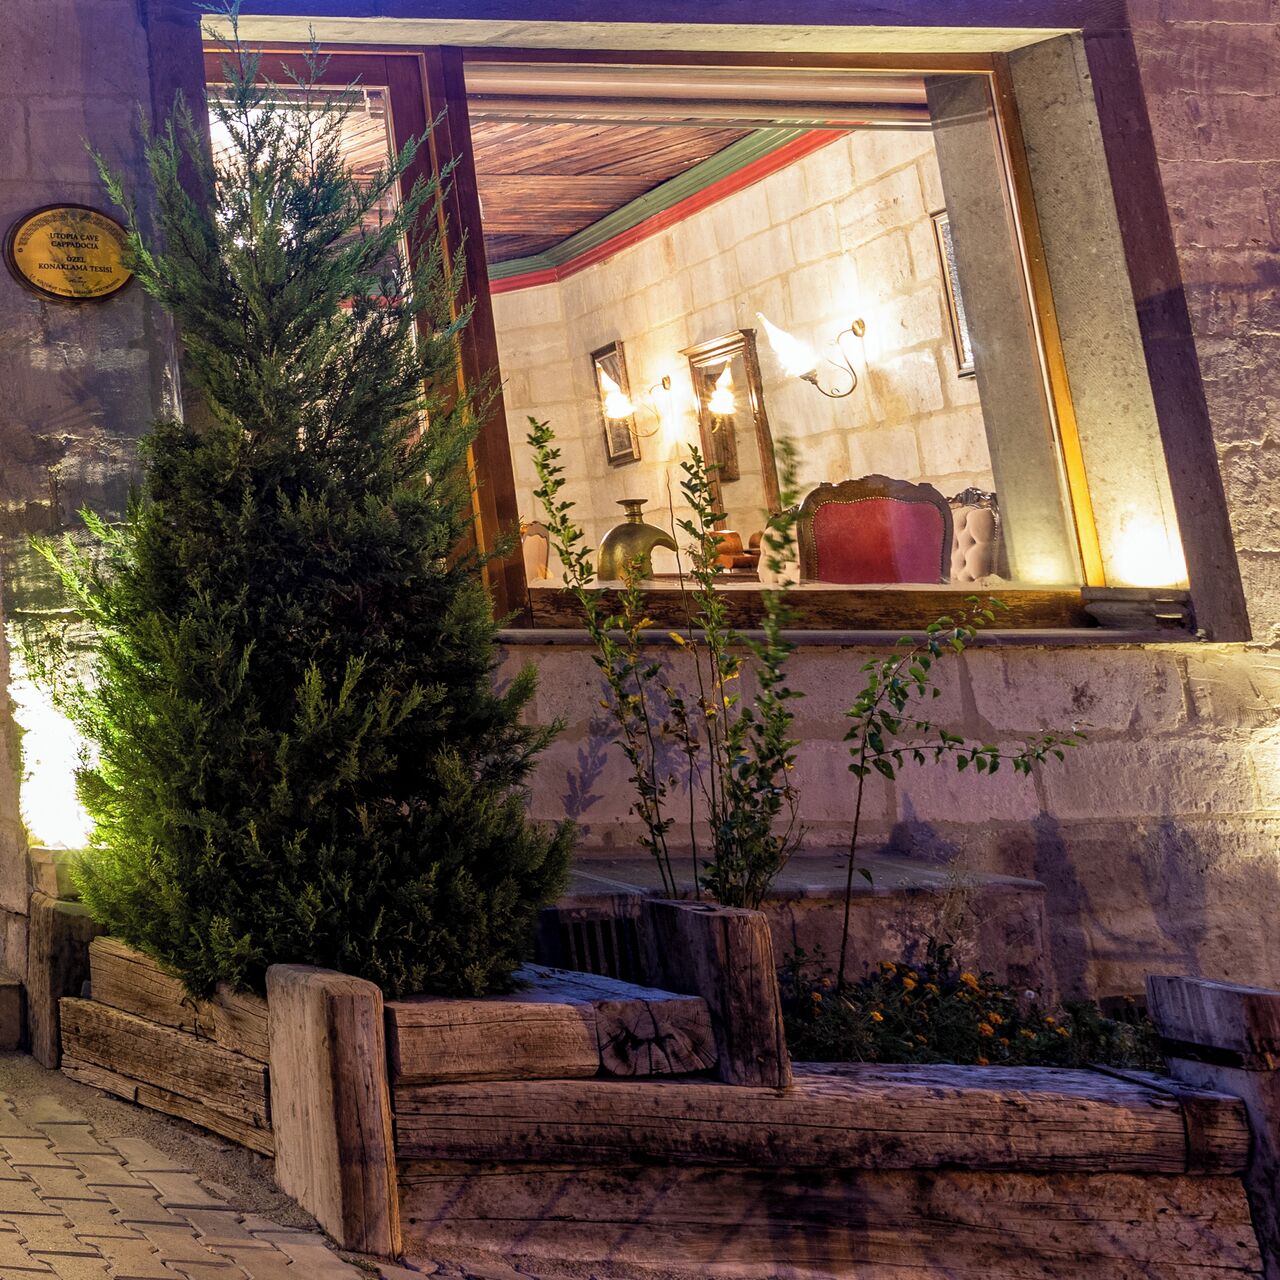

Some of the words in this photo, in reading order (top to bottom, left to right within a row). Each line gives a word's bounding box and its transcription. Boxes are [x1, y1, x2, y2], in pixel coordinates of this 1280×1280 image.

[49, 232, 78, 241] UTOPIA
[80, 234, 100, 242] CAVE
[51, 240, 99, 250] CAPPADOCIA
[38, 263, 88, 272] KONAKLAMA
